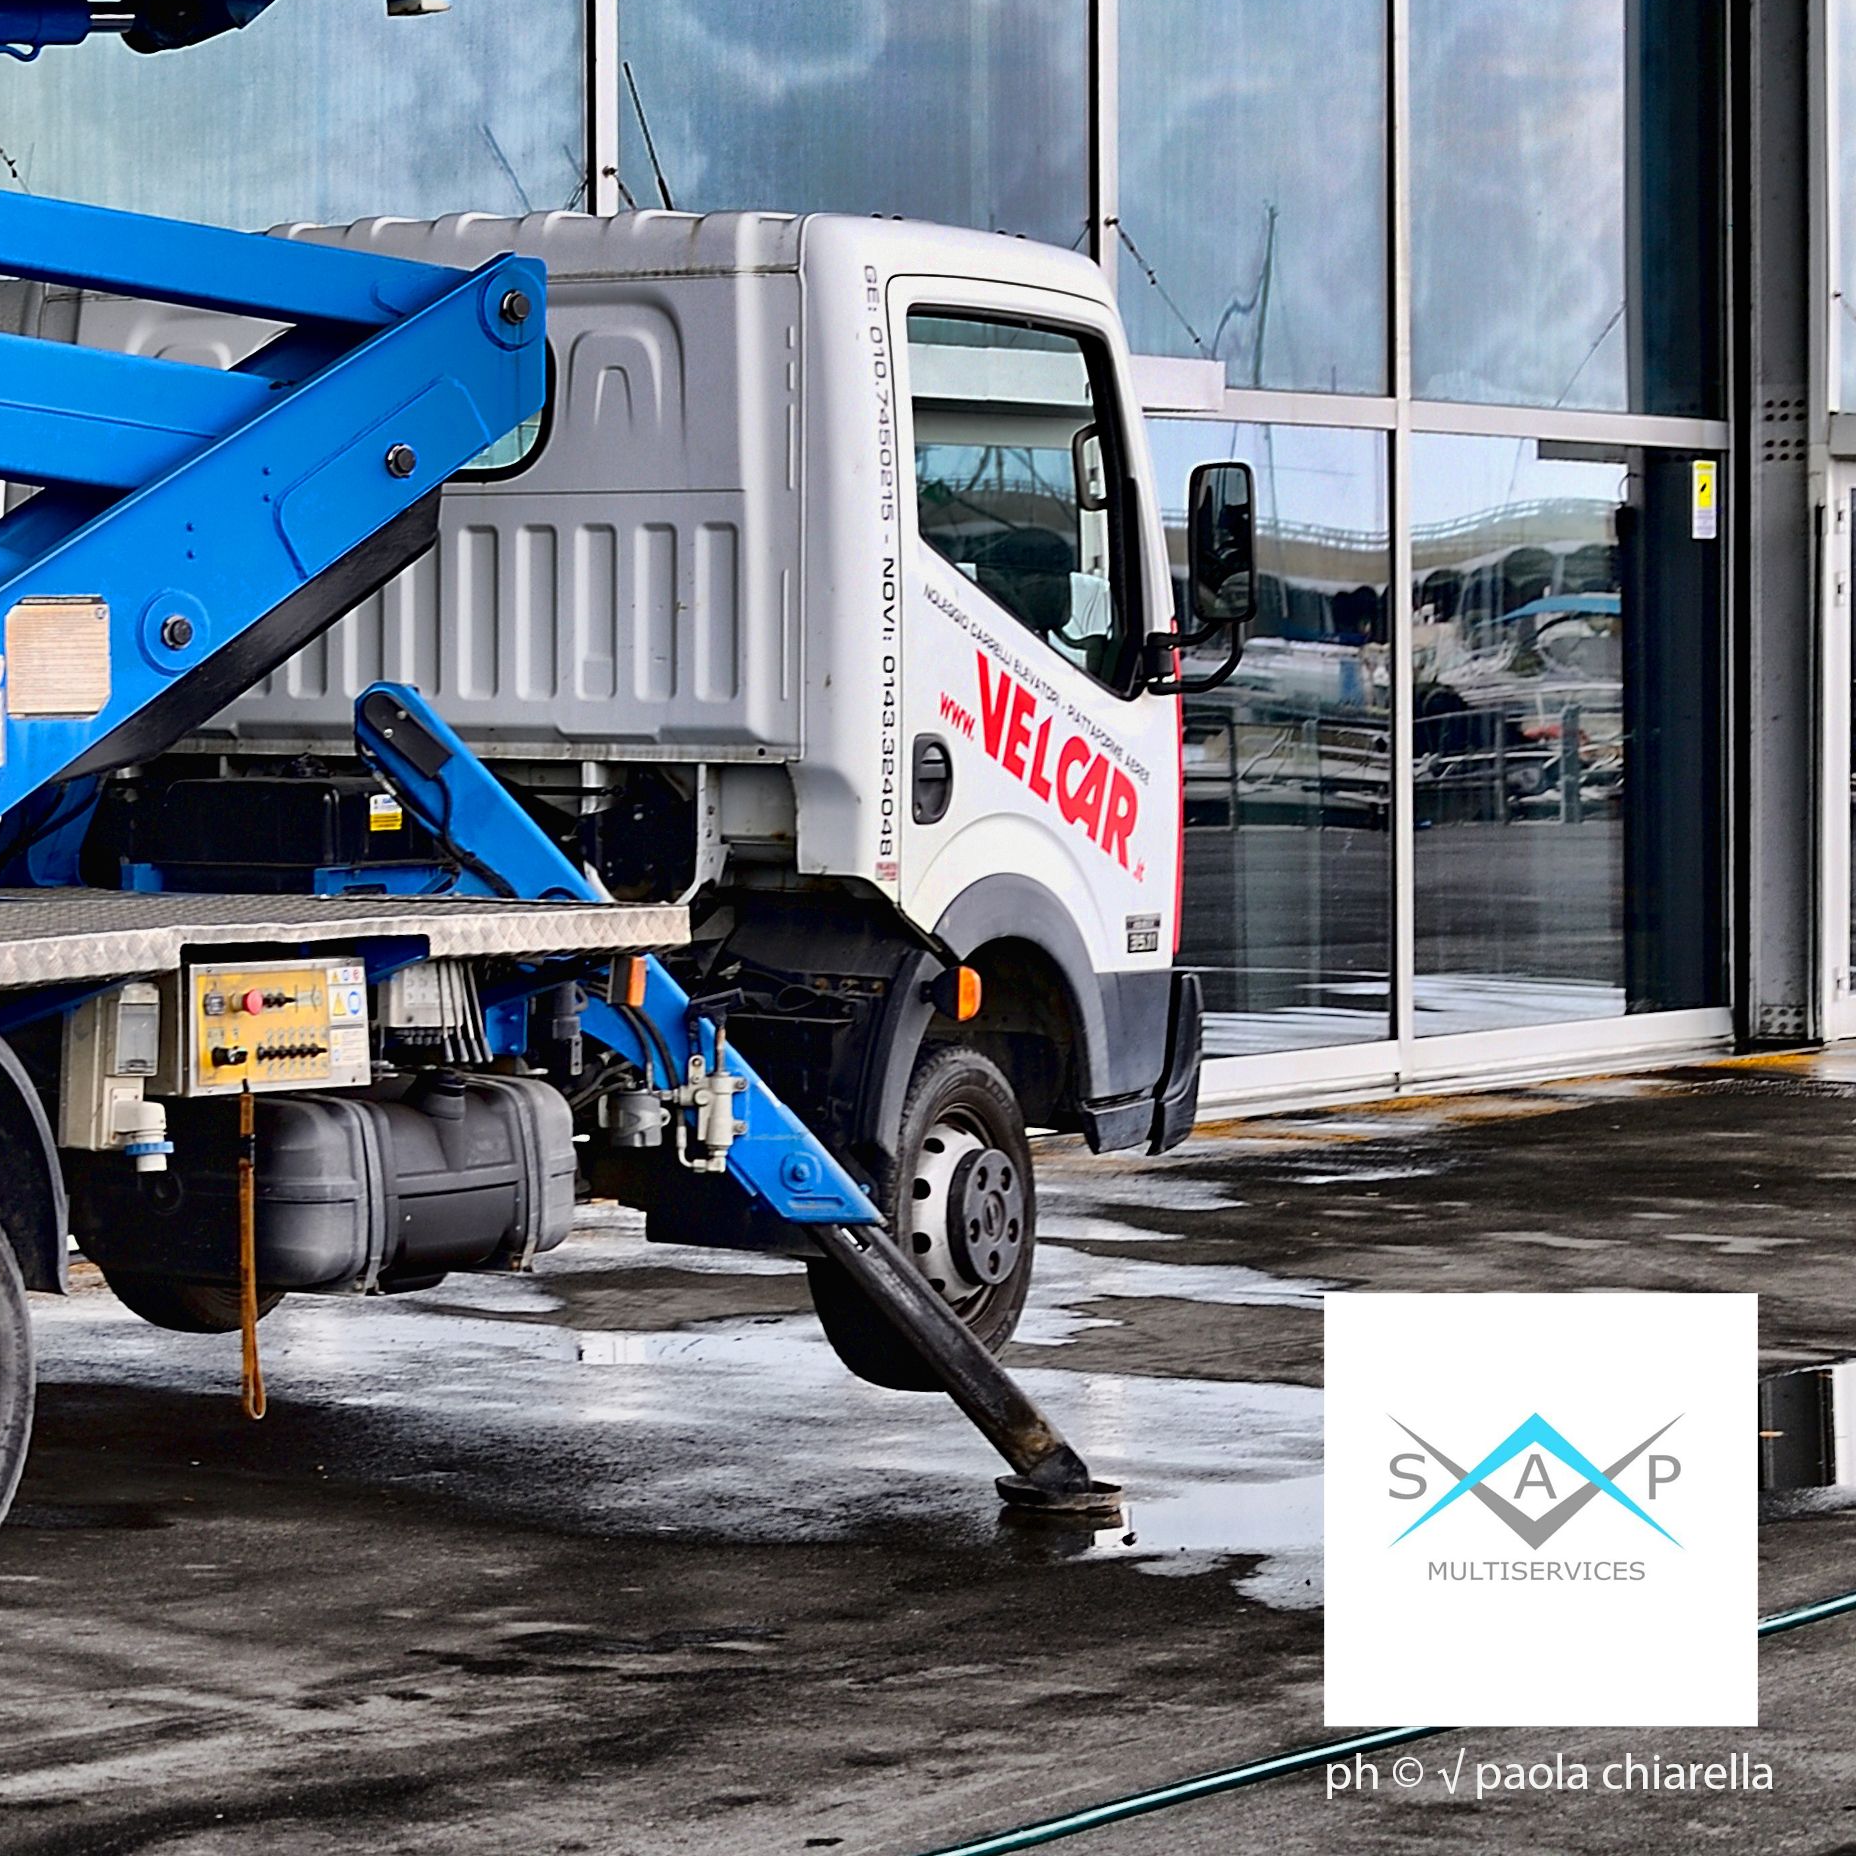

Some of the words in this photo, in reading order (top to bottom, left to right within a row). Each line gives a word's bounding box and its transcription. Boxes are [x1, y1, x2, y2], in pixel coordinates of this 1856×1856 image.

[864, 264, 881, 312] GE:
[869, 326, 895, 522] 010.7450215
[882, 556, 896, 642] NOVI:
[880, 654, 896, 856] 0143.324048
